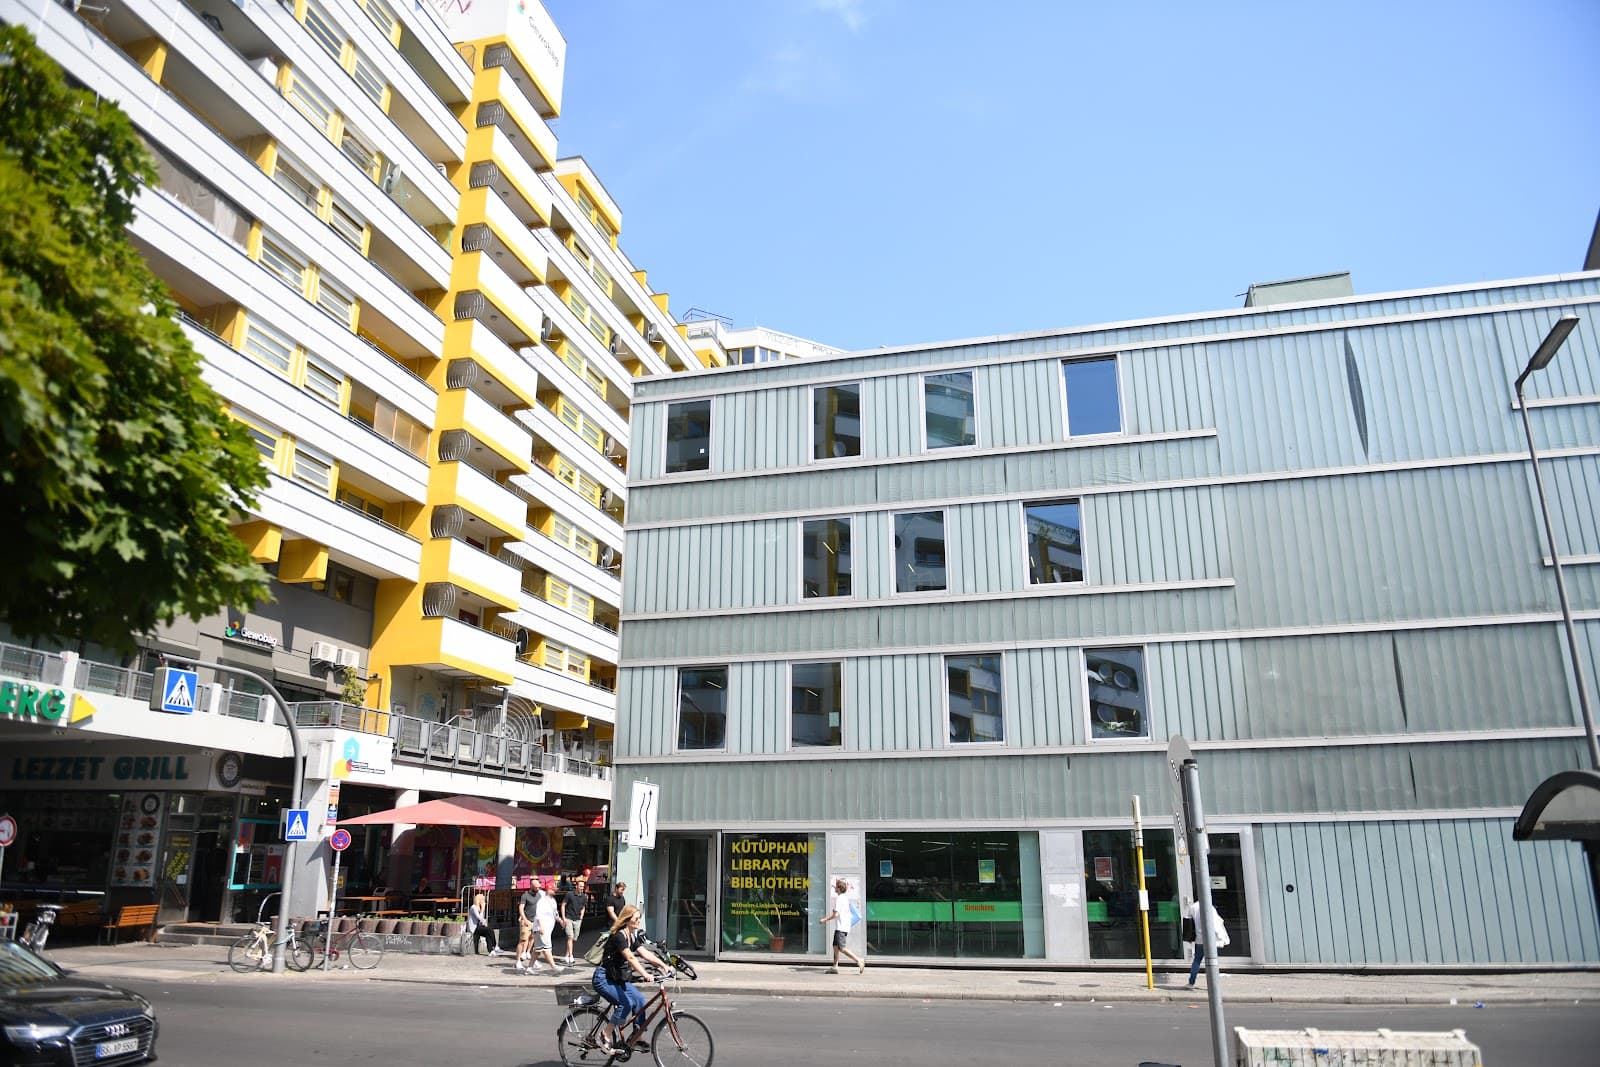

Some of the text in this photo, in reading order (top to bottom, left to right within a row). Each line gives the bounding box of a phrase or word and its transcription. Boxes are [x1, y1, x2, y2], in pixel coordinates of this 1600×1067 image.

[241, 627, 278, 647] Gewobag
[11, 755, 104, 781] LEZZET
[113, 755, 190, 780] GRILL
[731, 838, 815, 854] KÜTÜPHANE
[731, 858, 790, 871] LIBRARY
[731, 876, 812, 889] BIBLIOTHEK
